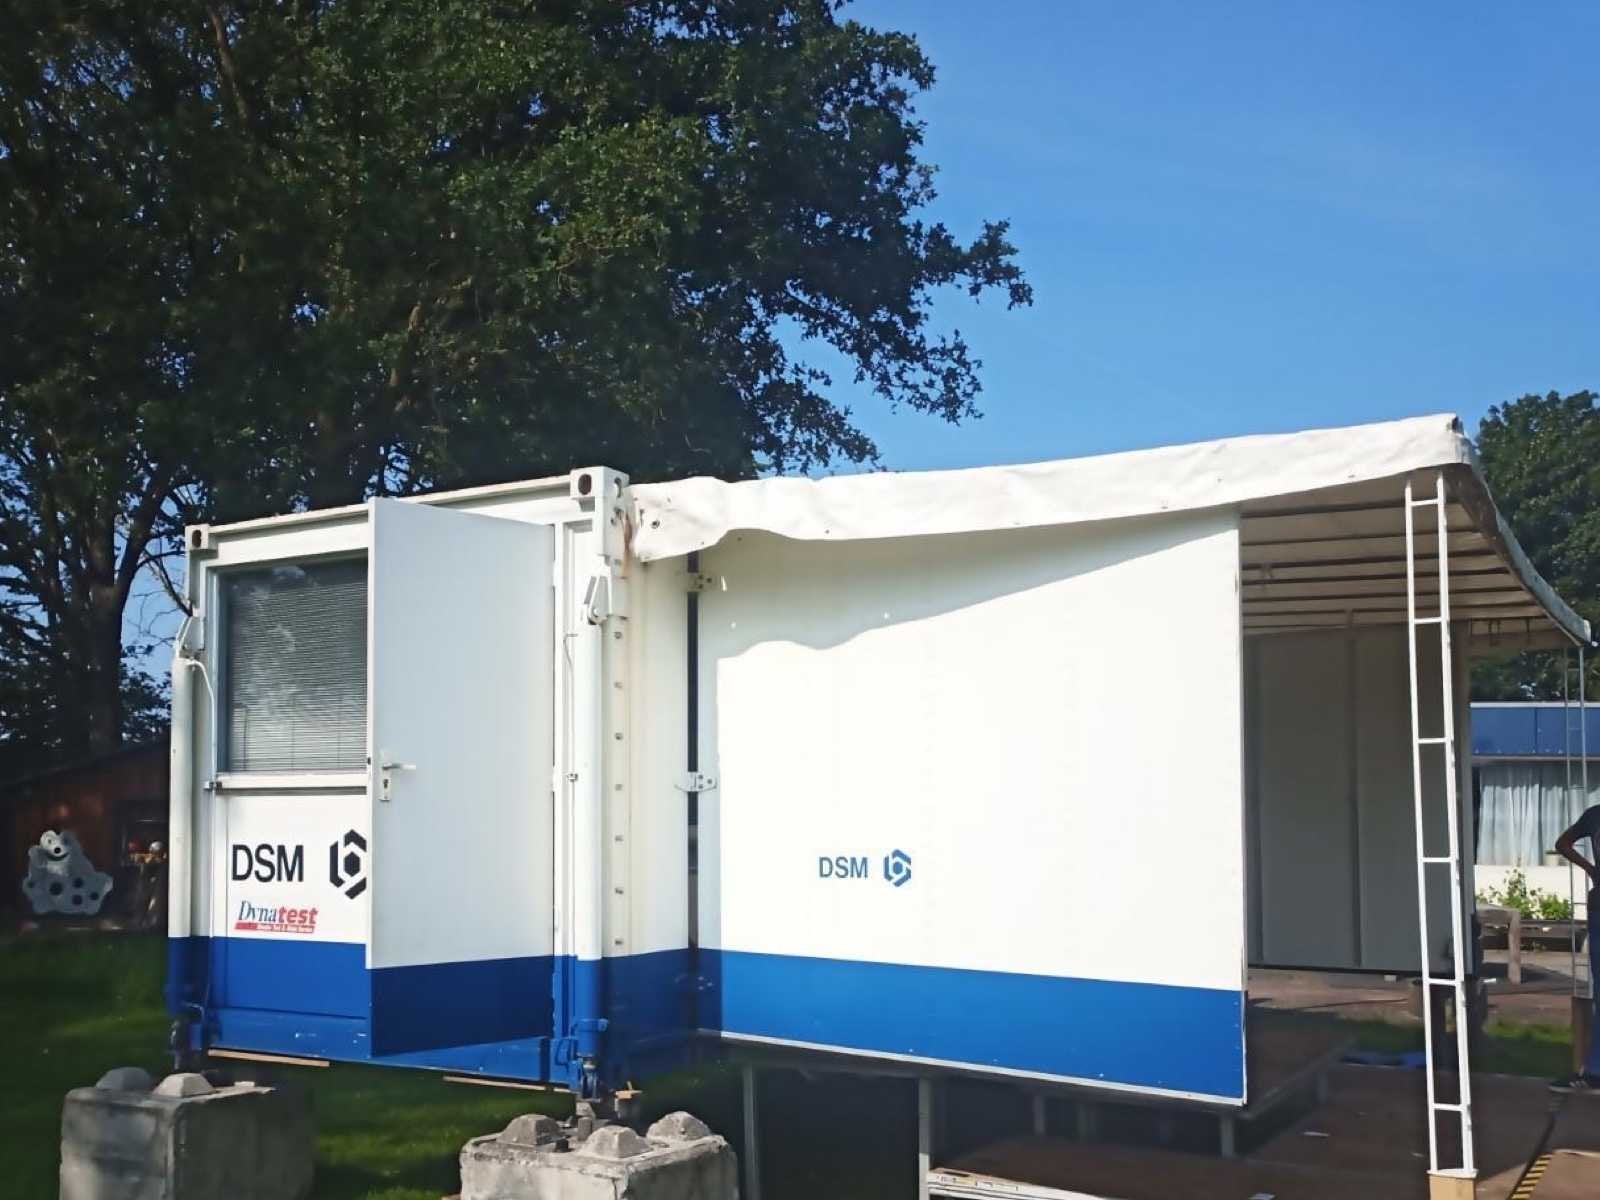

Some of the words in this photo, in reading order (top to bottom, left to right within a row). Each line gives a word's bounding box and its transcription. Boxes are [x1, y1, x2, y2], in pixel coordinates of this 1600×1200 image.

[232, 843, 304, 883] DSM
[819, 856, 868, 879] DSM
[238, 900, 318, 924] Dynatest
